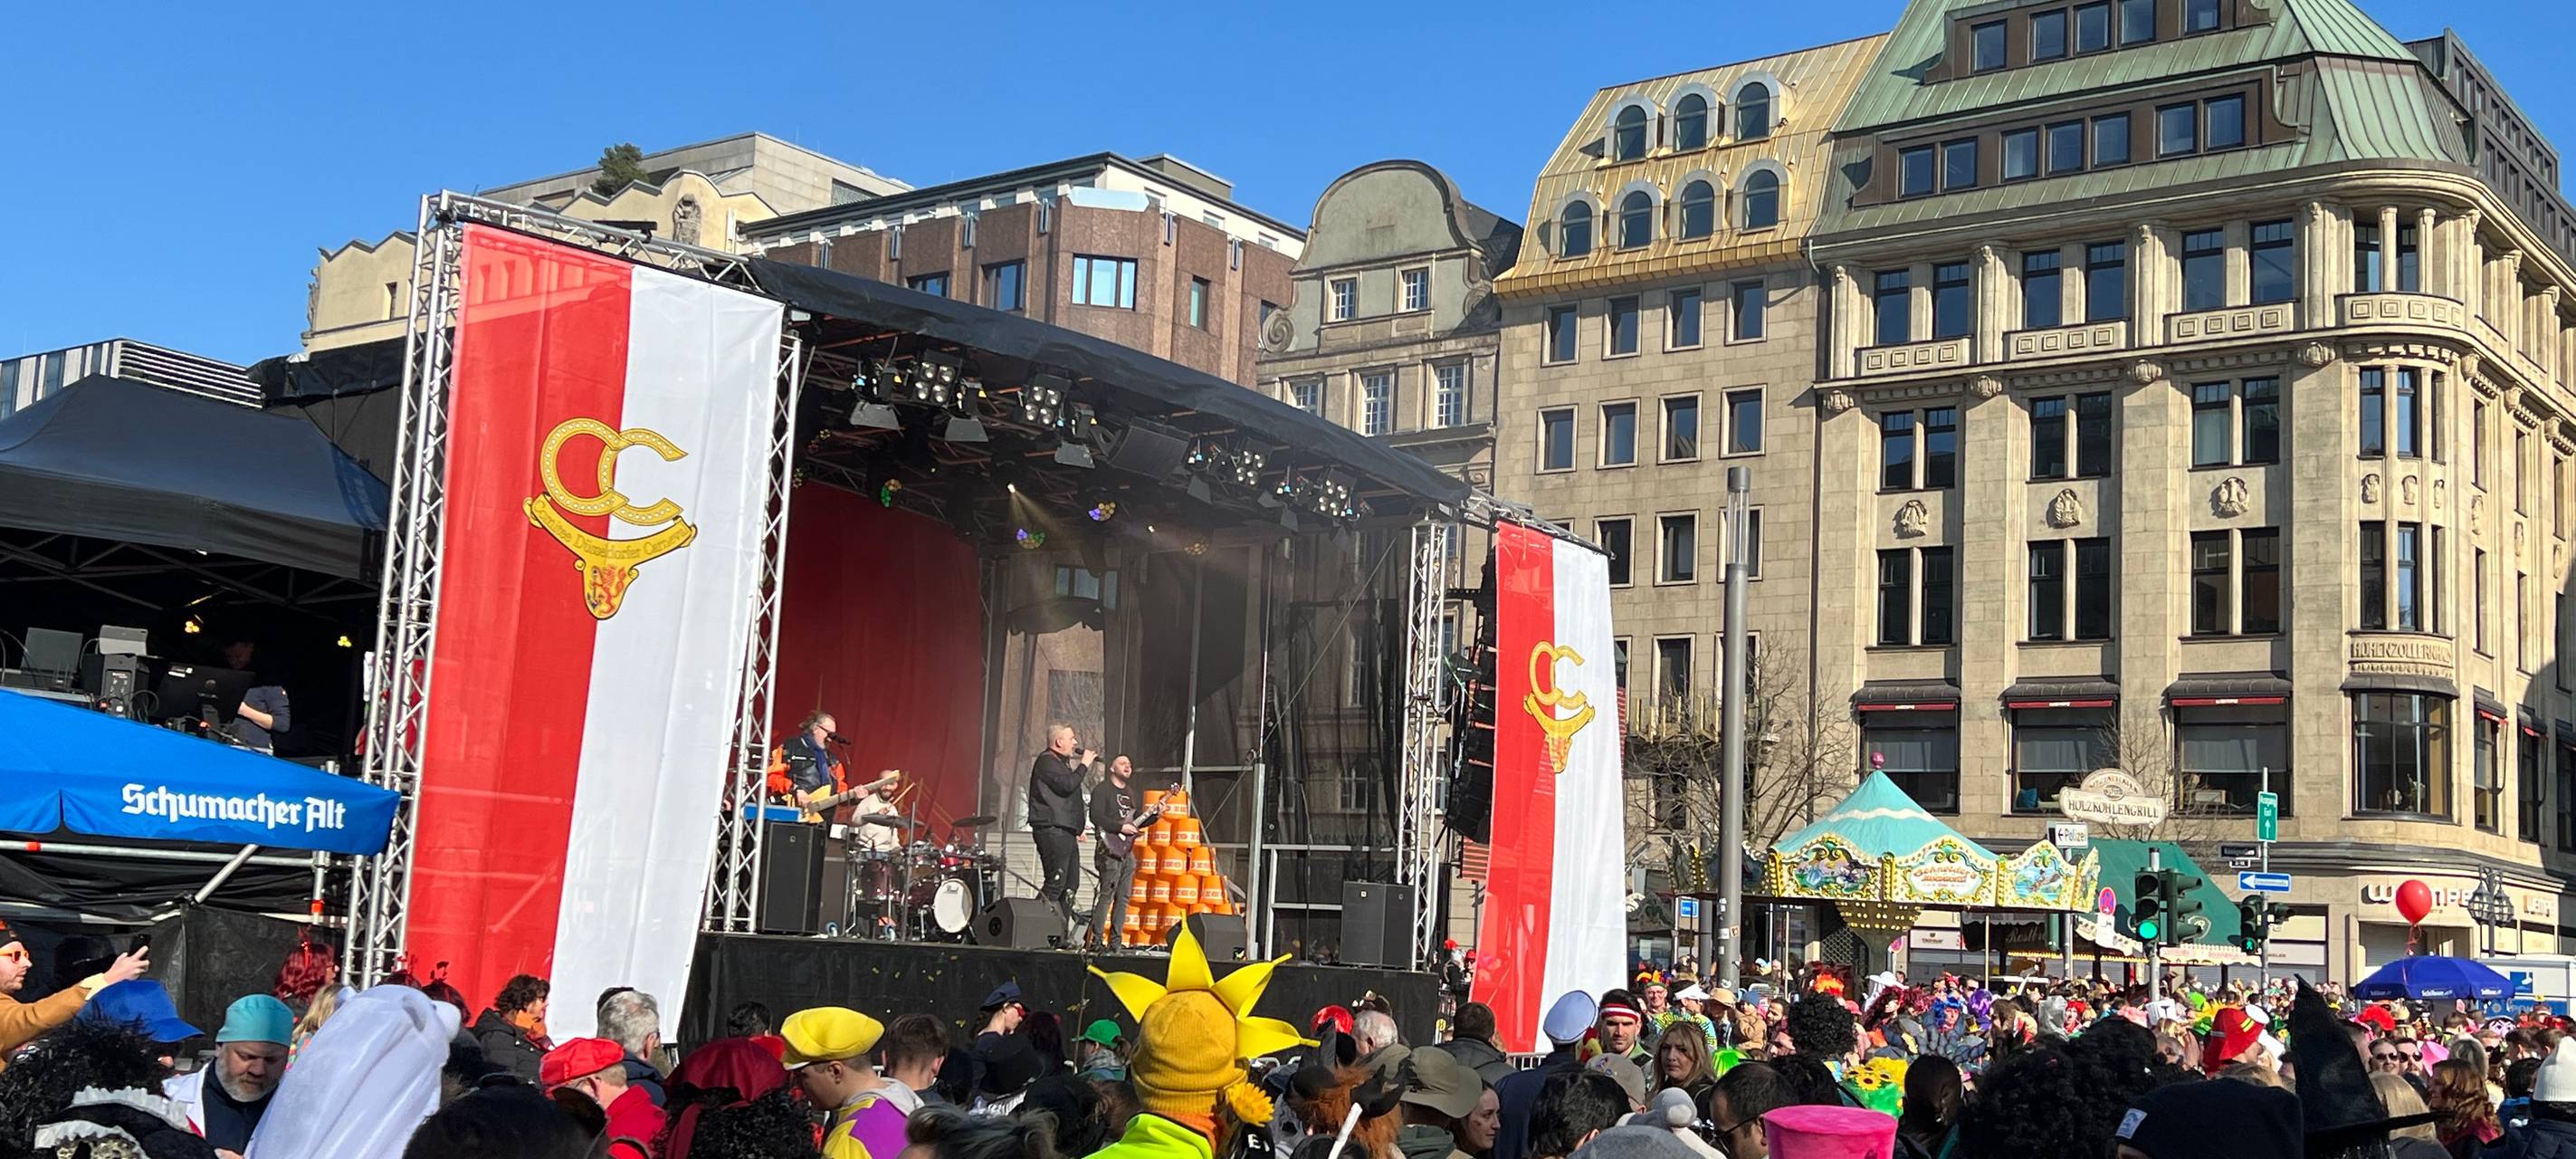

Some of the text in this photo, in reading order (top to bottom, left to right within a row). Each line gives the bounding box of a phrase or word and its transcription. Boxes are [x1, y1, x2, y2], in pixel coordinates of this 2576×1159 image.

[121, 782, 347, 833] Schumacher Alt
[2068, 800, 2160, 819] HOLZKOHLENGRILL
